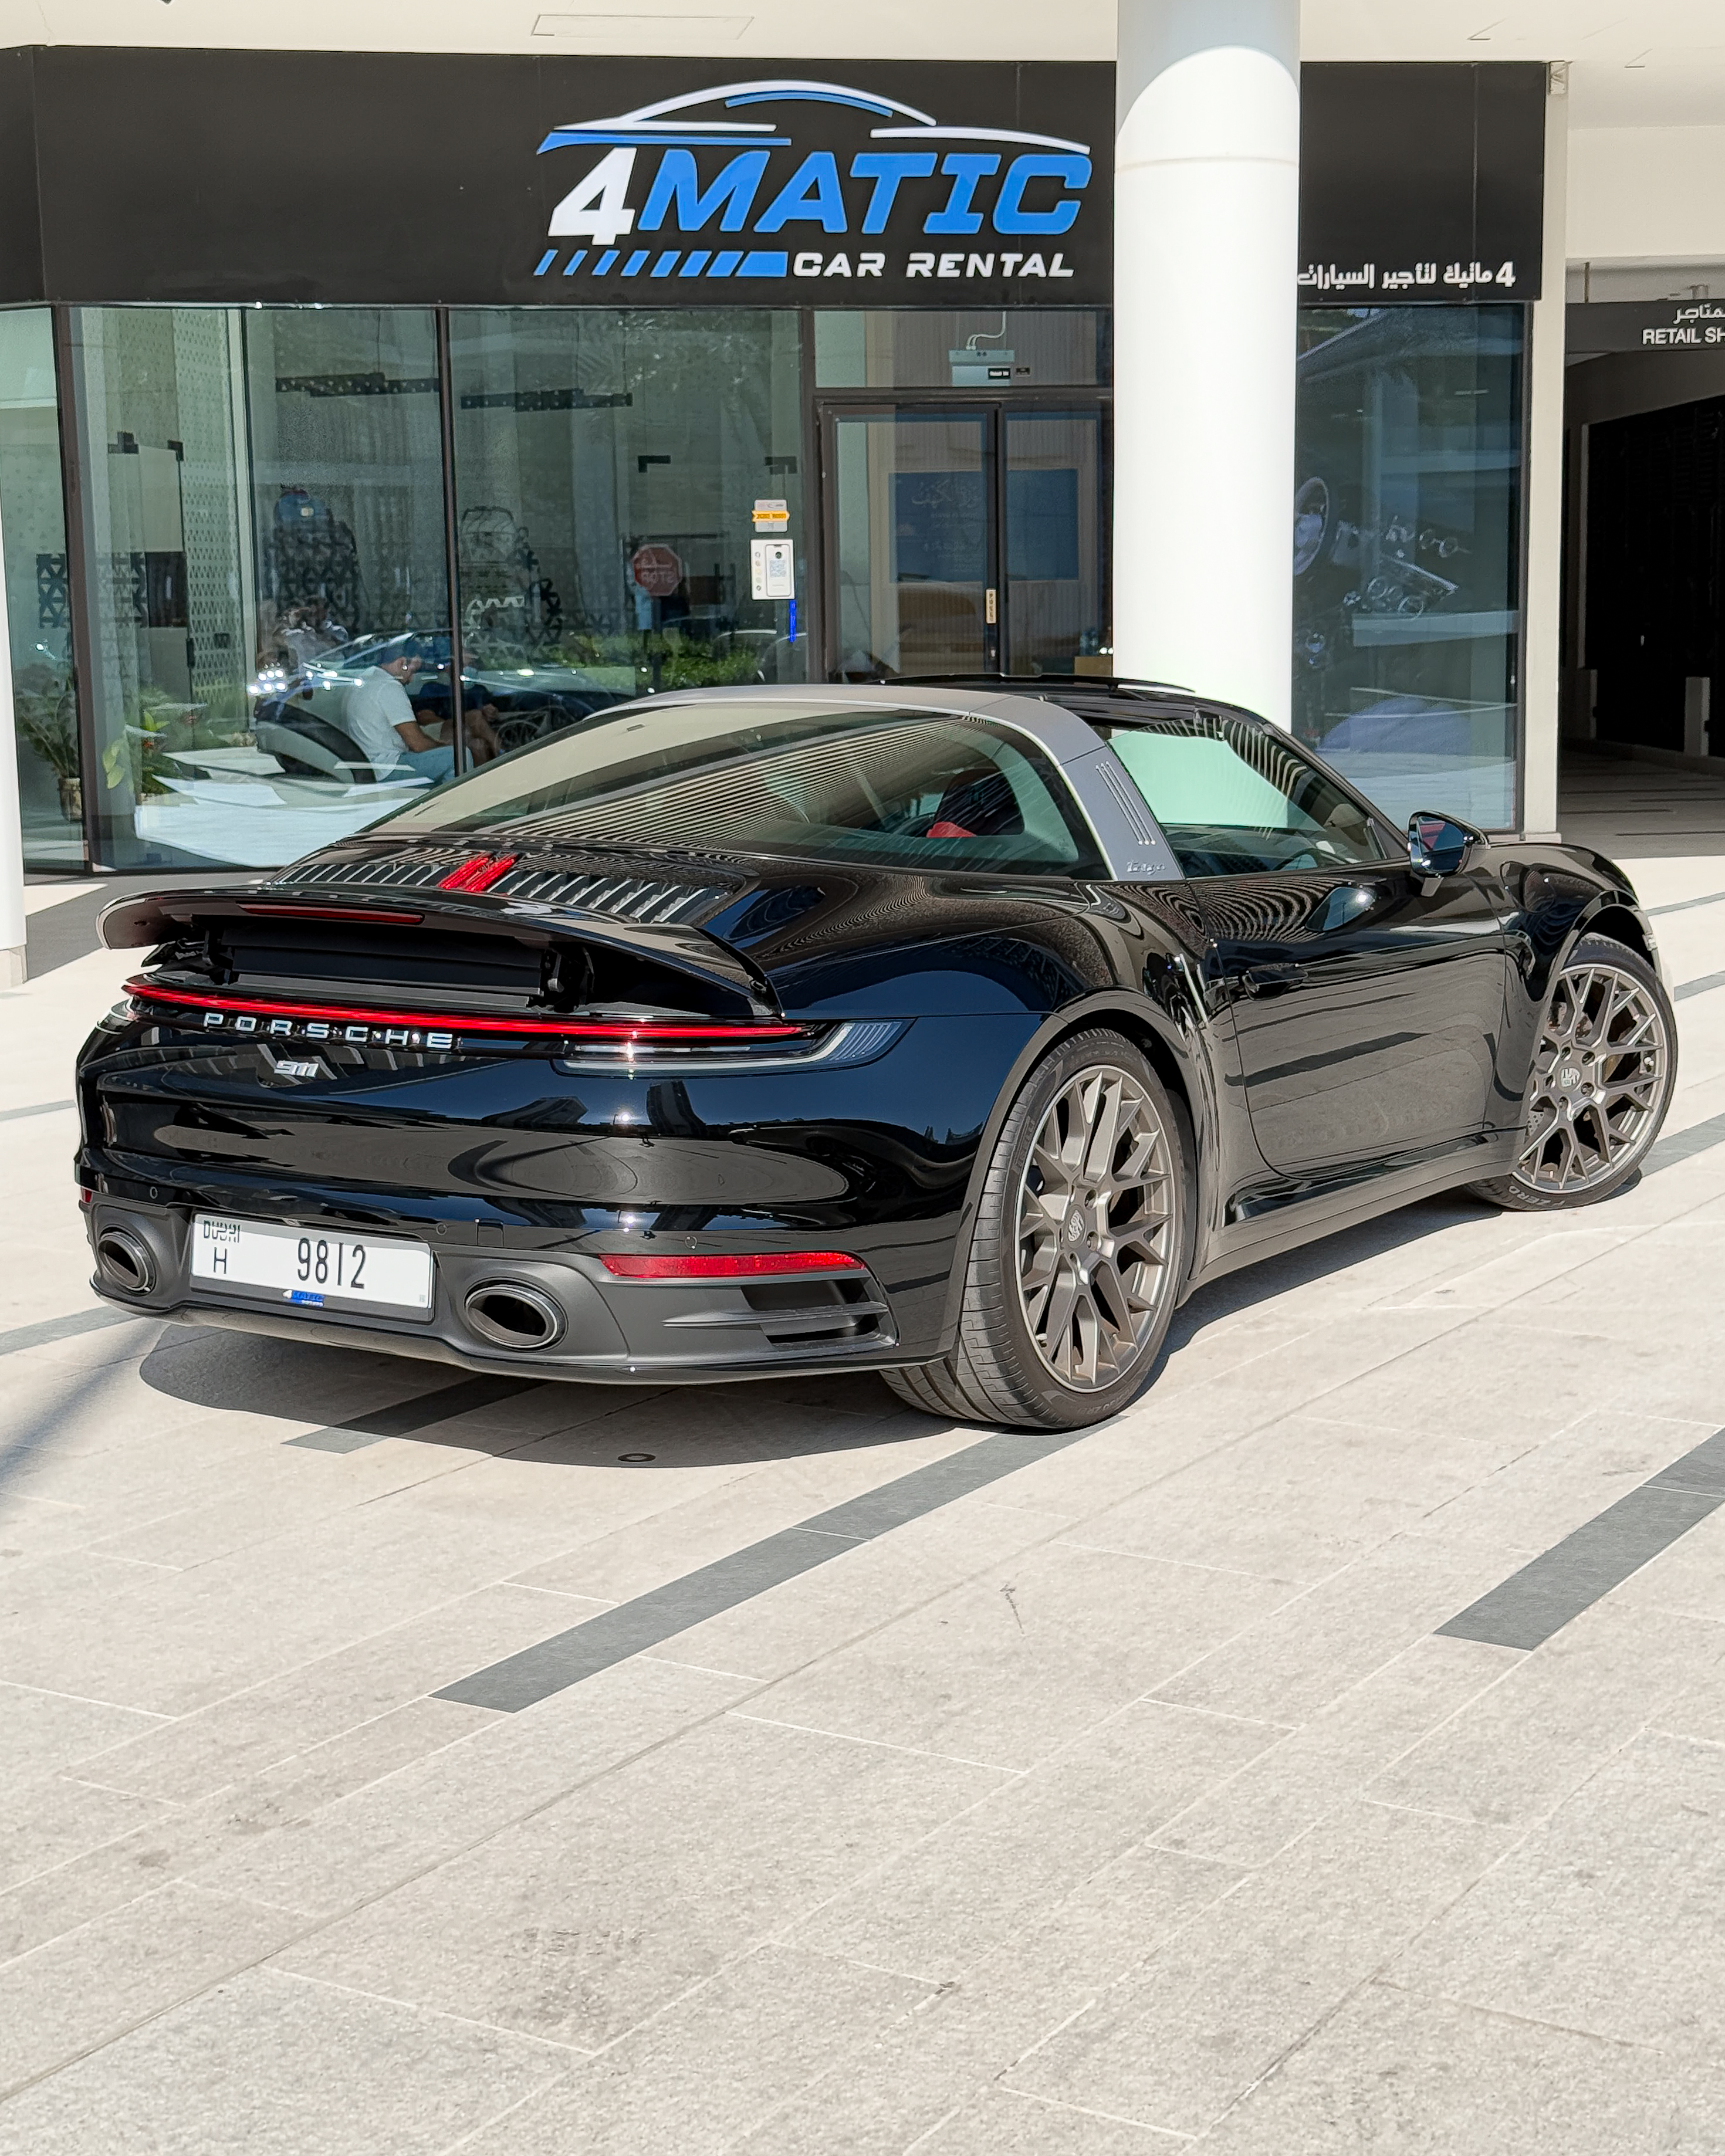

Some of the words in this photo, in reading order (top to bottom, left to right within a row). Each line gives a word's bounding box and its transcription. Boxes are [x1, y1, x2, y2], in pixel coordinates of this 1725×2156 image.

[548, 148, 1092, 246] 4MATIC
[793, 252, 885, 278] CAR
[905, 252, 1074, 278] RENTAL
[1642, 327, 1702, 345] RETAIL
[204, 1012, 453, 1050] PORSCHE
[273, 1060, 320, 1079] 911
[1508, 1185, 1551, 1205] ZERO
[212, 1246, 228, 1275] H
[297, 1237, 366, 1289] 9812
